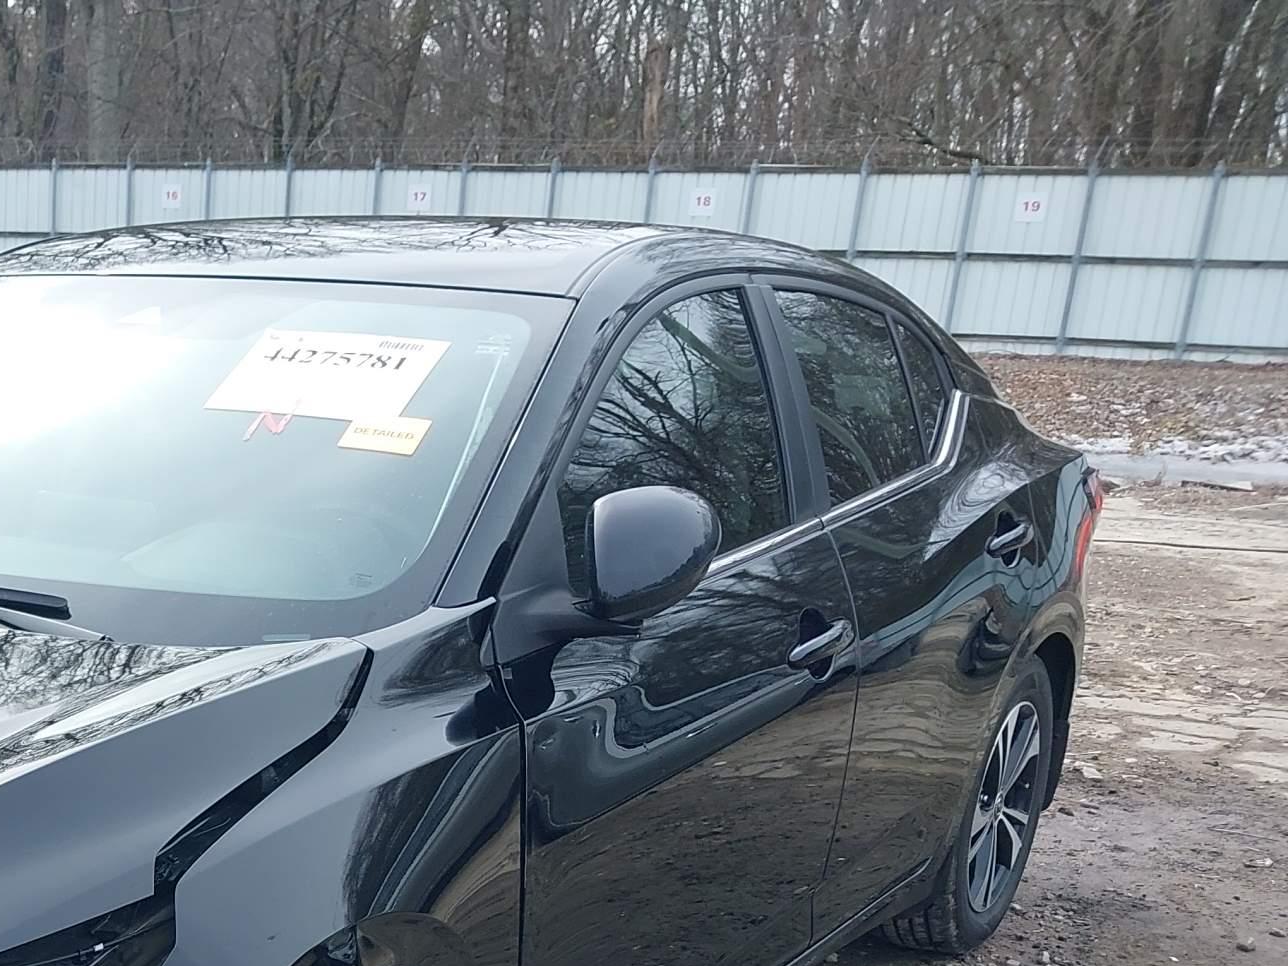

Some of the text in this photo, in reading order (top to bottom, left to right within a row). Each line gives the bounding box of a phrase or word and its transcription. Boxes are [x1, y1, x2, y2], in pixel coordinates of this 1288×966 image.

[413, 191, 427, 201] 17
[696, 195, 712, 207] 18
[1023, 200, 1041, 212] 19
[263, 347, 408, 370] 44275781
[353, 426, 416, 441] DETAILED
